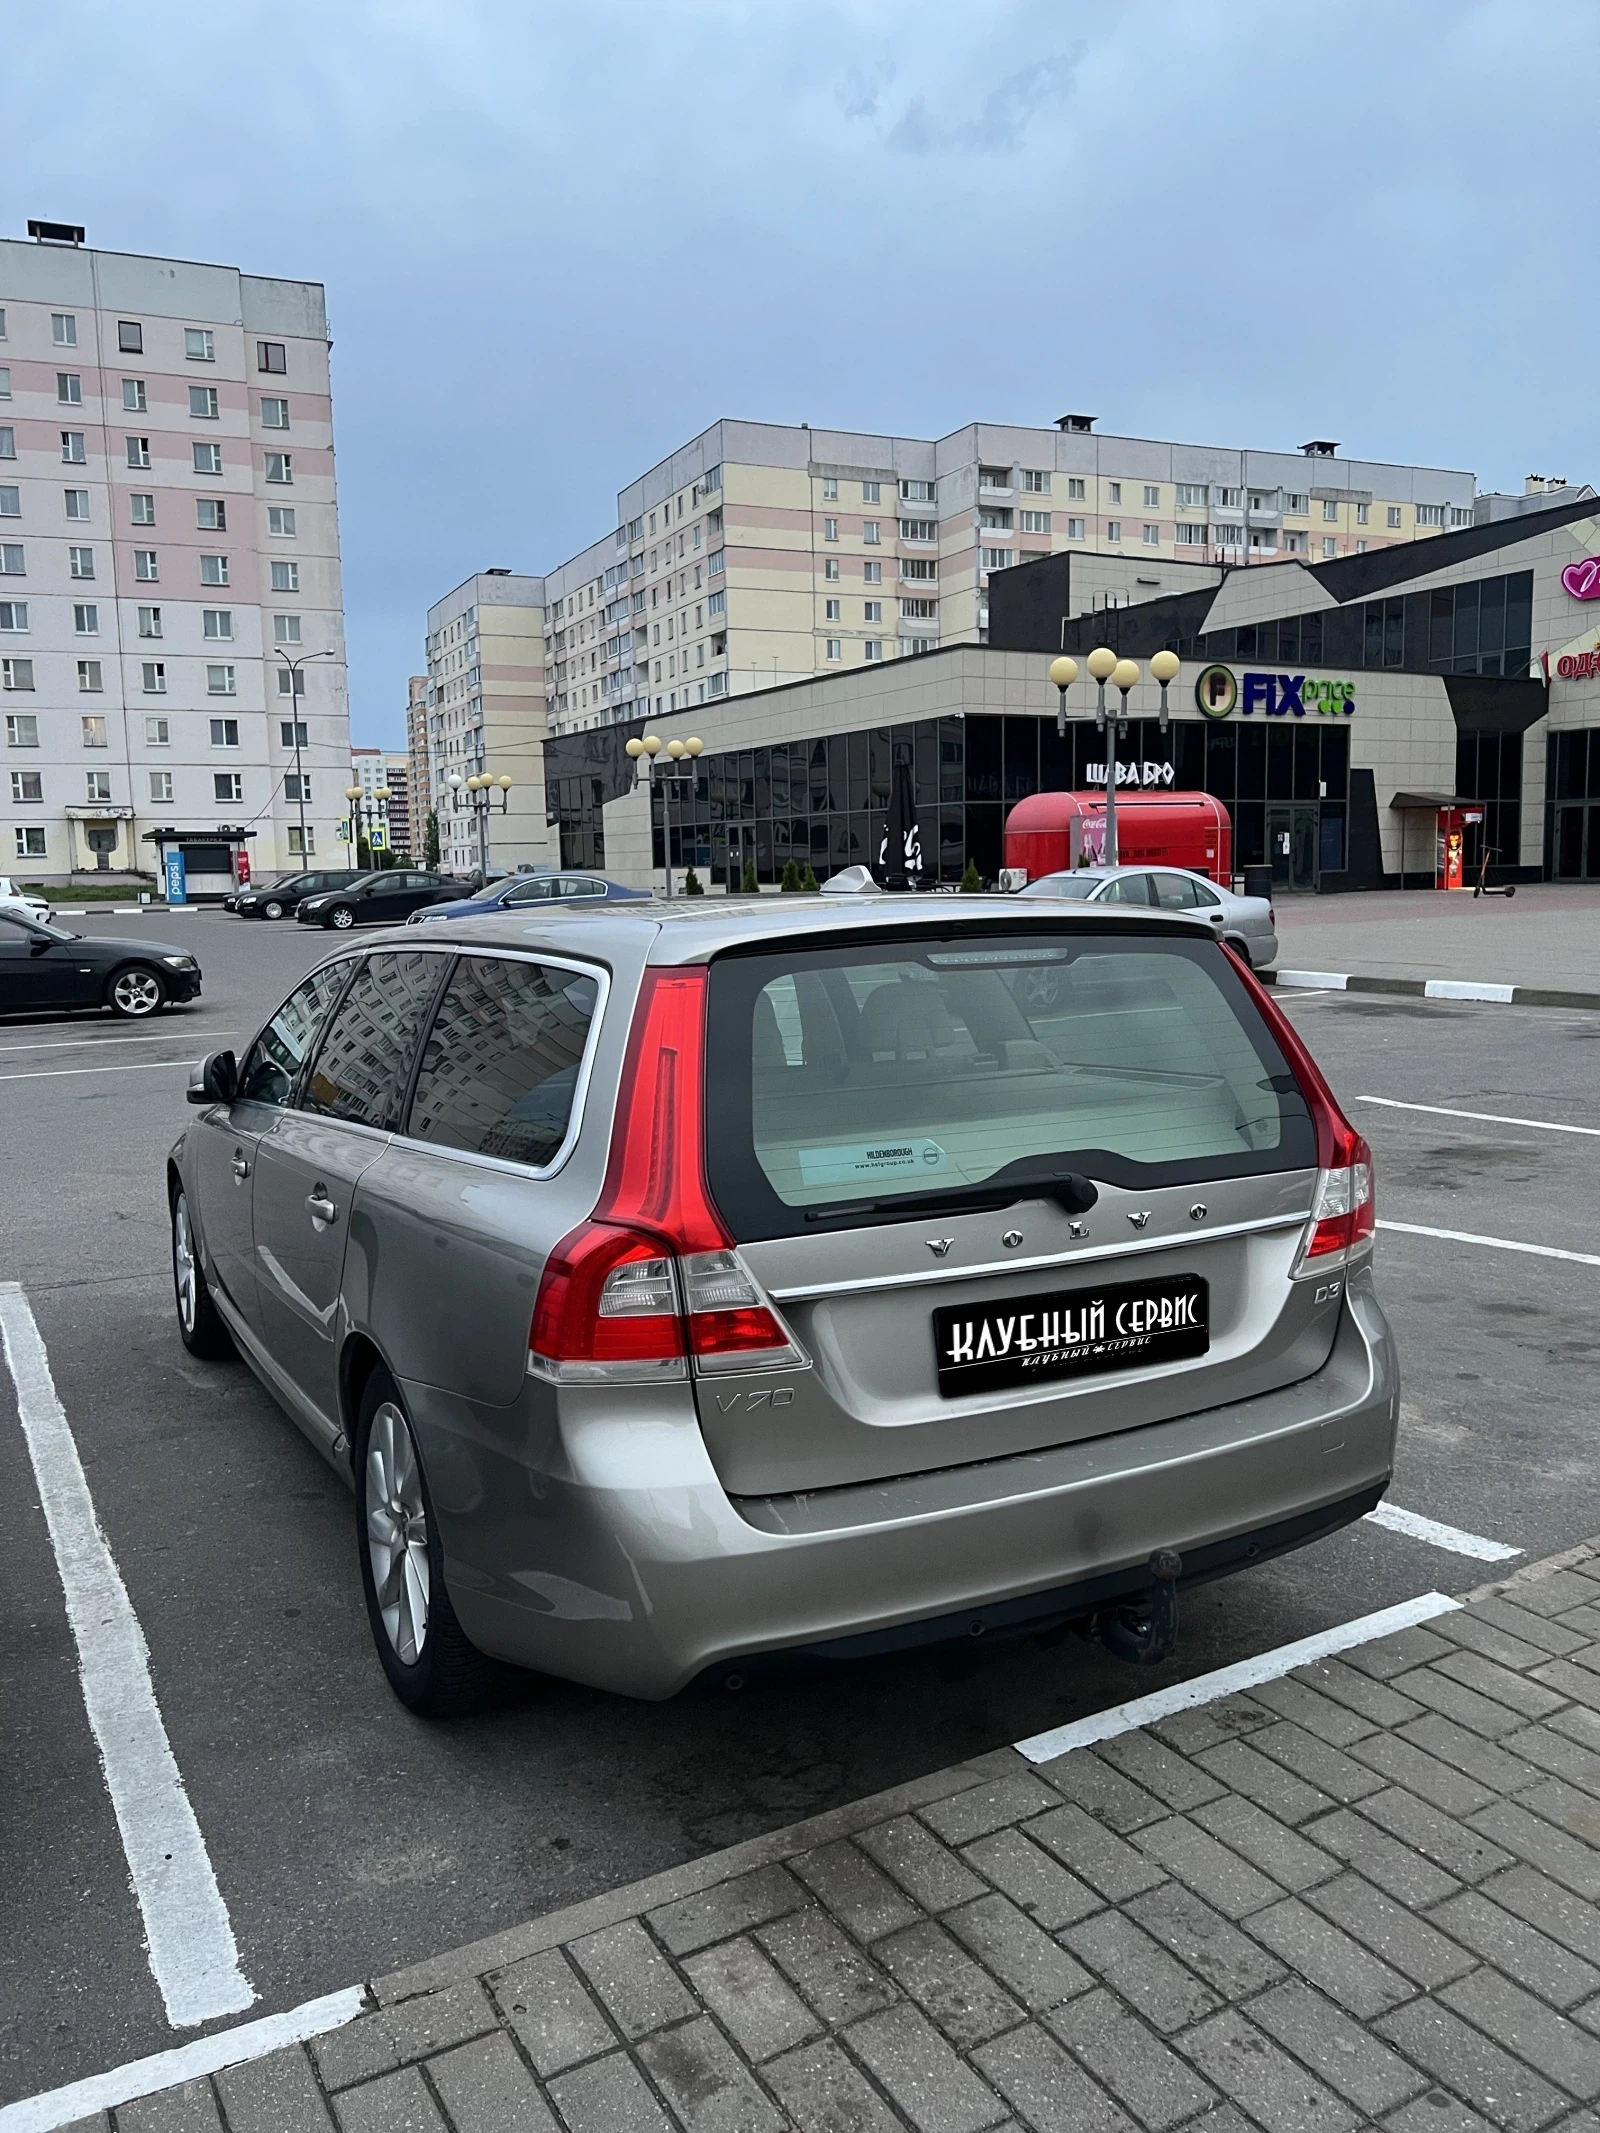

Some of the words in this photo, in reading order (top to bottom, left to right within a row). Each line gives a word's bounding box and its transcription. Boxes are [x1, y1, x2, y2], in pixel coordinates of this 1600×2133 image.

[1302, 680, 1356, 703] price
[1143, 761, 1175, 785] БРО
[168, 862, 182, 895] pepsi
[866, 1148, 912, 1159] HILDENBOROUGH
[925, 1203, 1208, 1258] VOLVO
[1314, 1281, 1341, 1305] D3
[946, 1300, 1105, 1363] КЛУБНЫЙ
[1115, 1294, 1198, 1335] СЕРВИС
[1021, 1345, 1090, 1367] КЛУБНЫЙ
[1107, 1336, 1151, 1351] СЕРВИС
